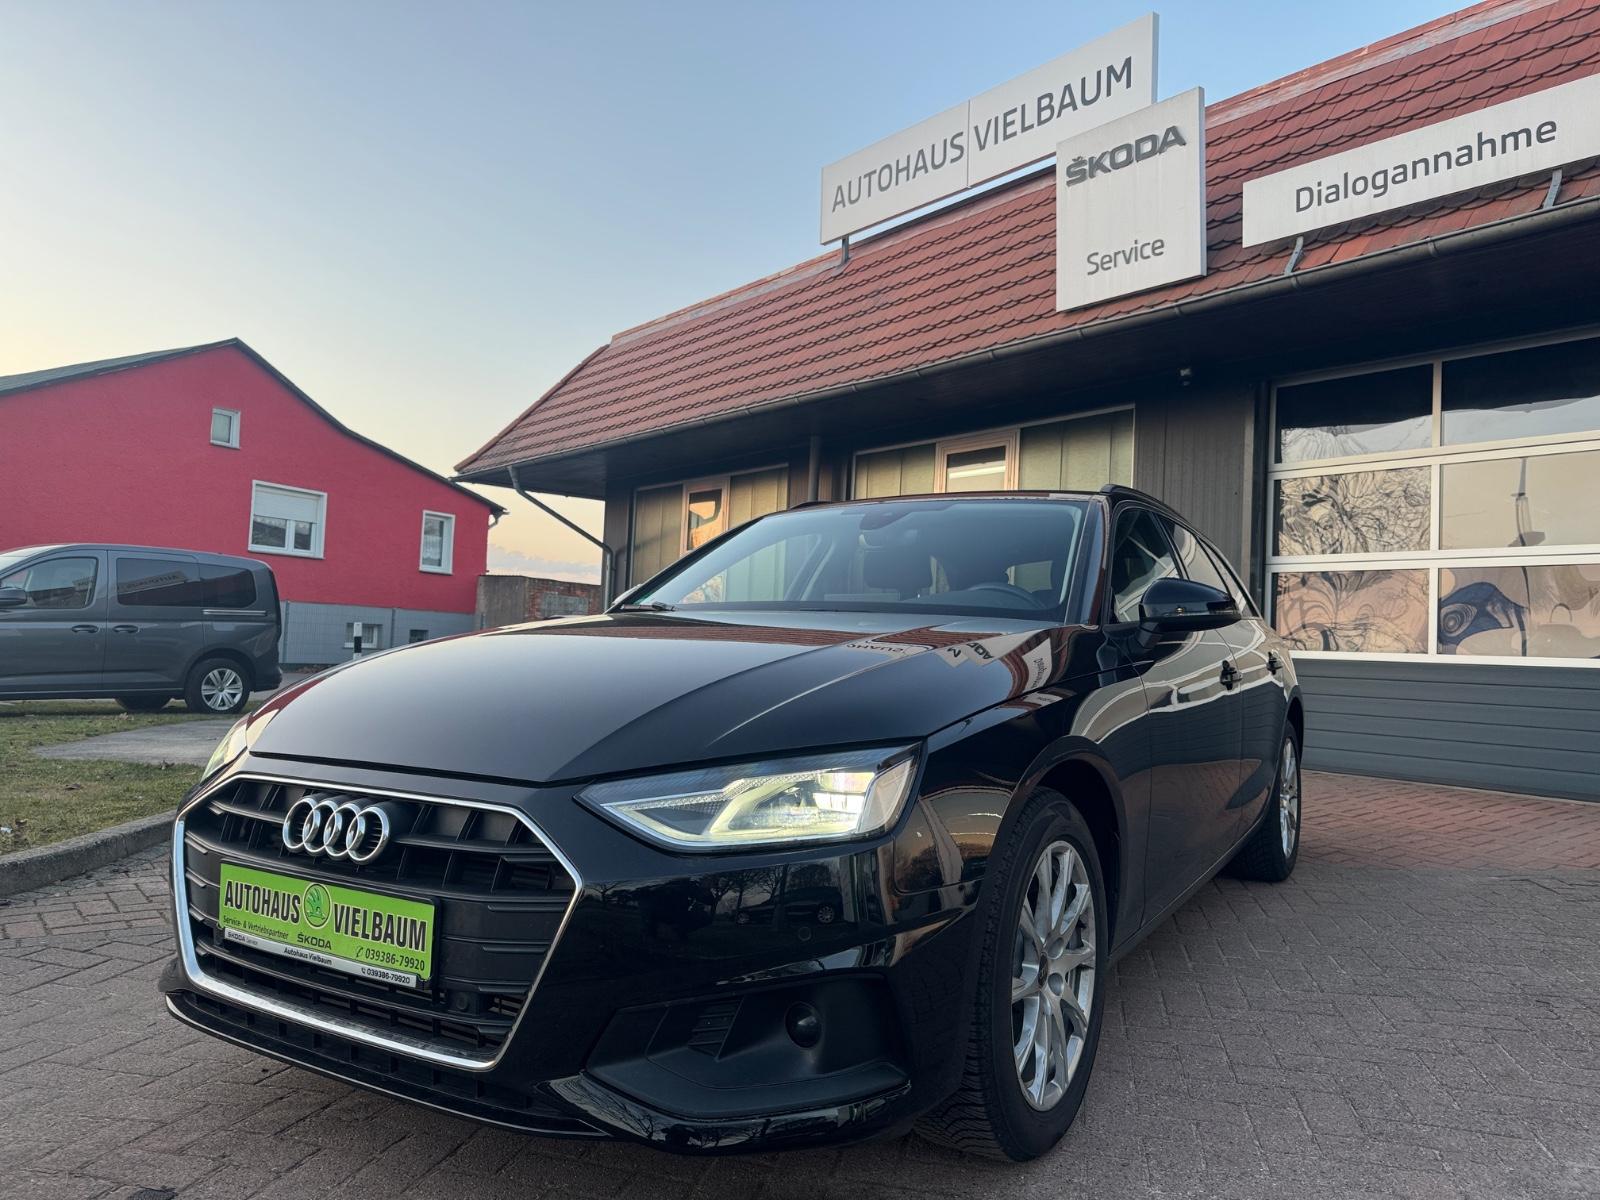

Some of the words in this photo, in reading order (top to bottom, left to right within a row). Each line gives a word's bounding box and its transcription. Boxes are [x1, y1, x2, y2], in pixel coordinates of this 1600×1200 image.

[831, 130, 964, 213] AUTOHAUS
[974, 56, 1132, 151] VIELBAUM
[1066, 125, 1187, 187] ŠKODA
[1295, 120, 1557, 213] Dialogannahme
[1086, 239, 1165, 275] Service
[223, 880, 301, 924] AUTOHAUS
[334, 903, 427, 952] VIELBAUM
[248, 922, 289, 940] Vertriebspartner
[296, 931, 332, 951] ŠKODA
[284, 947, 308, 959] Autohaus
[308, 952, 332, 966] Vielbaum
[365, 948, 425, 972] 039386-79920
[366, 968, 411, 985] 039386-79920
